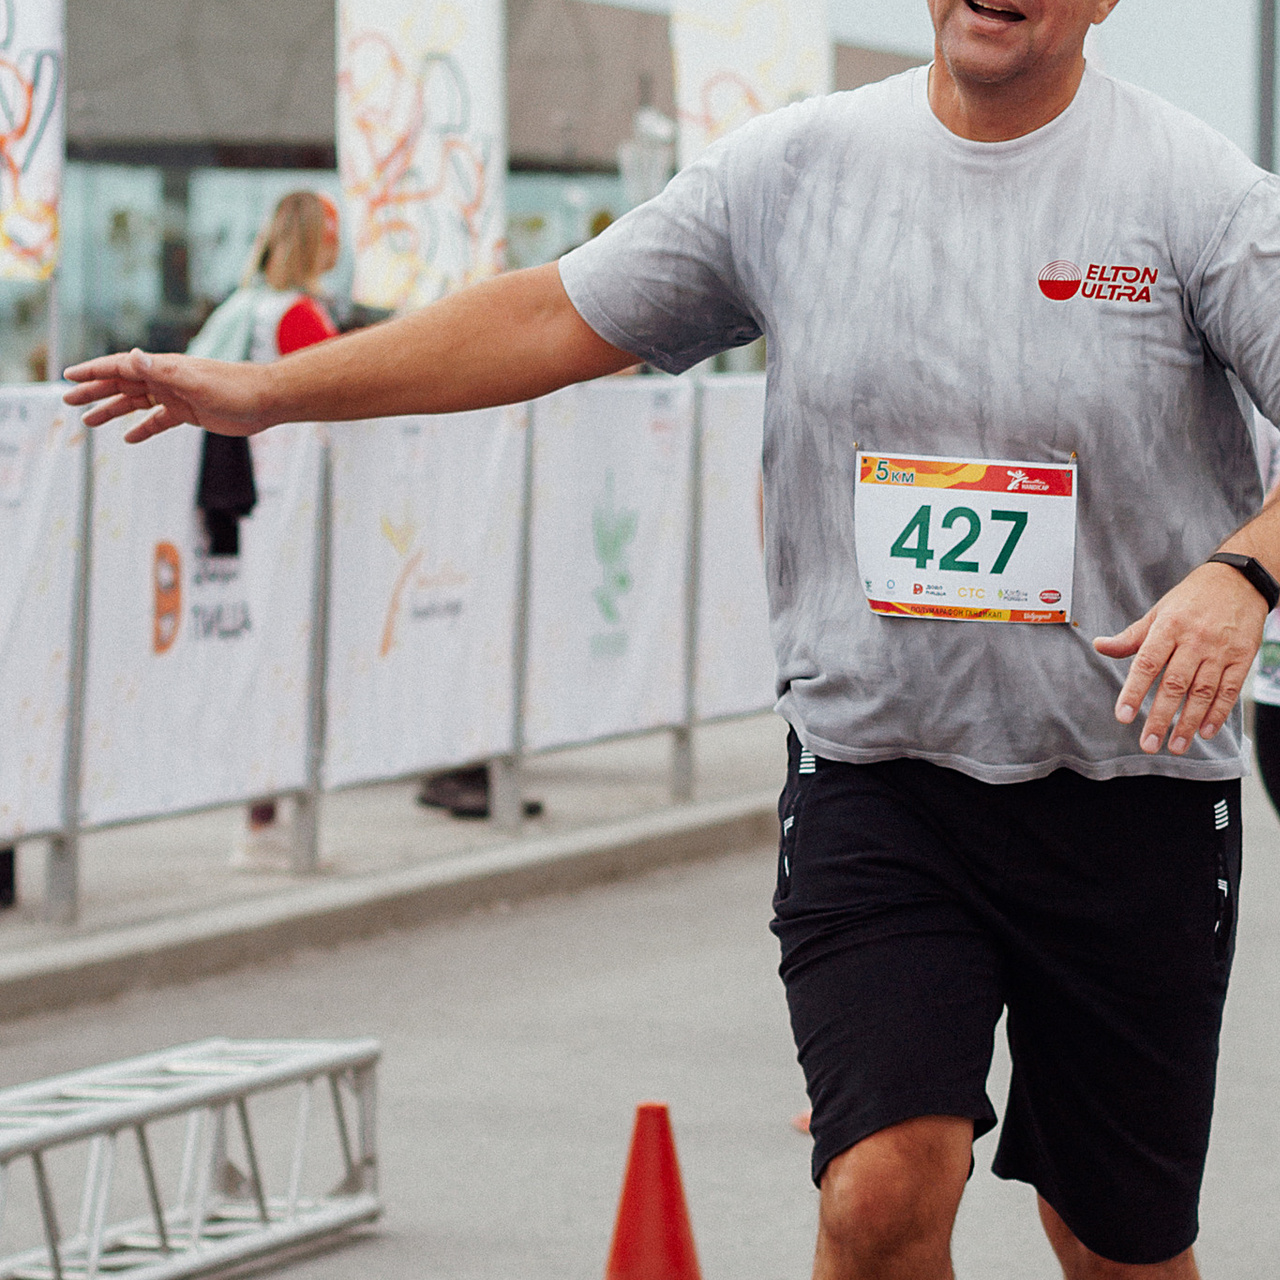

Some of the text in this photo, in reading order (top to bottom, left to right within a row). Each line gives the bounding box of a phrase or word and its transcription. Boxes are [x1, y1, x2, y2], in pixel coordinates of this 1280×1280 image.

[1086, 263, 1158, 284] ELTON
[1081, 281, 1151, 303] ULTRA
[890, 504, 1028, 575] 427
